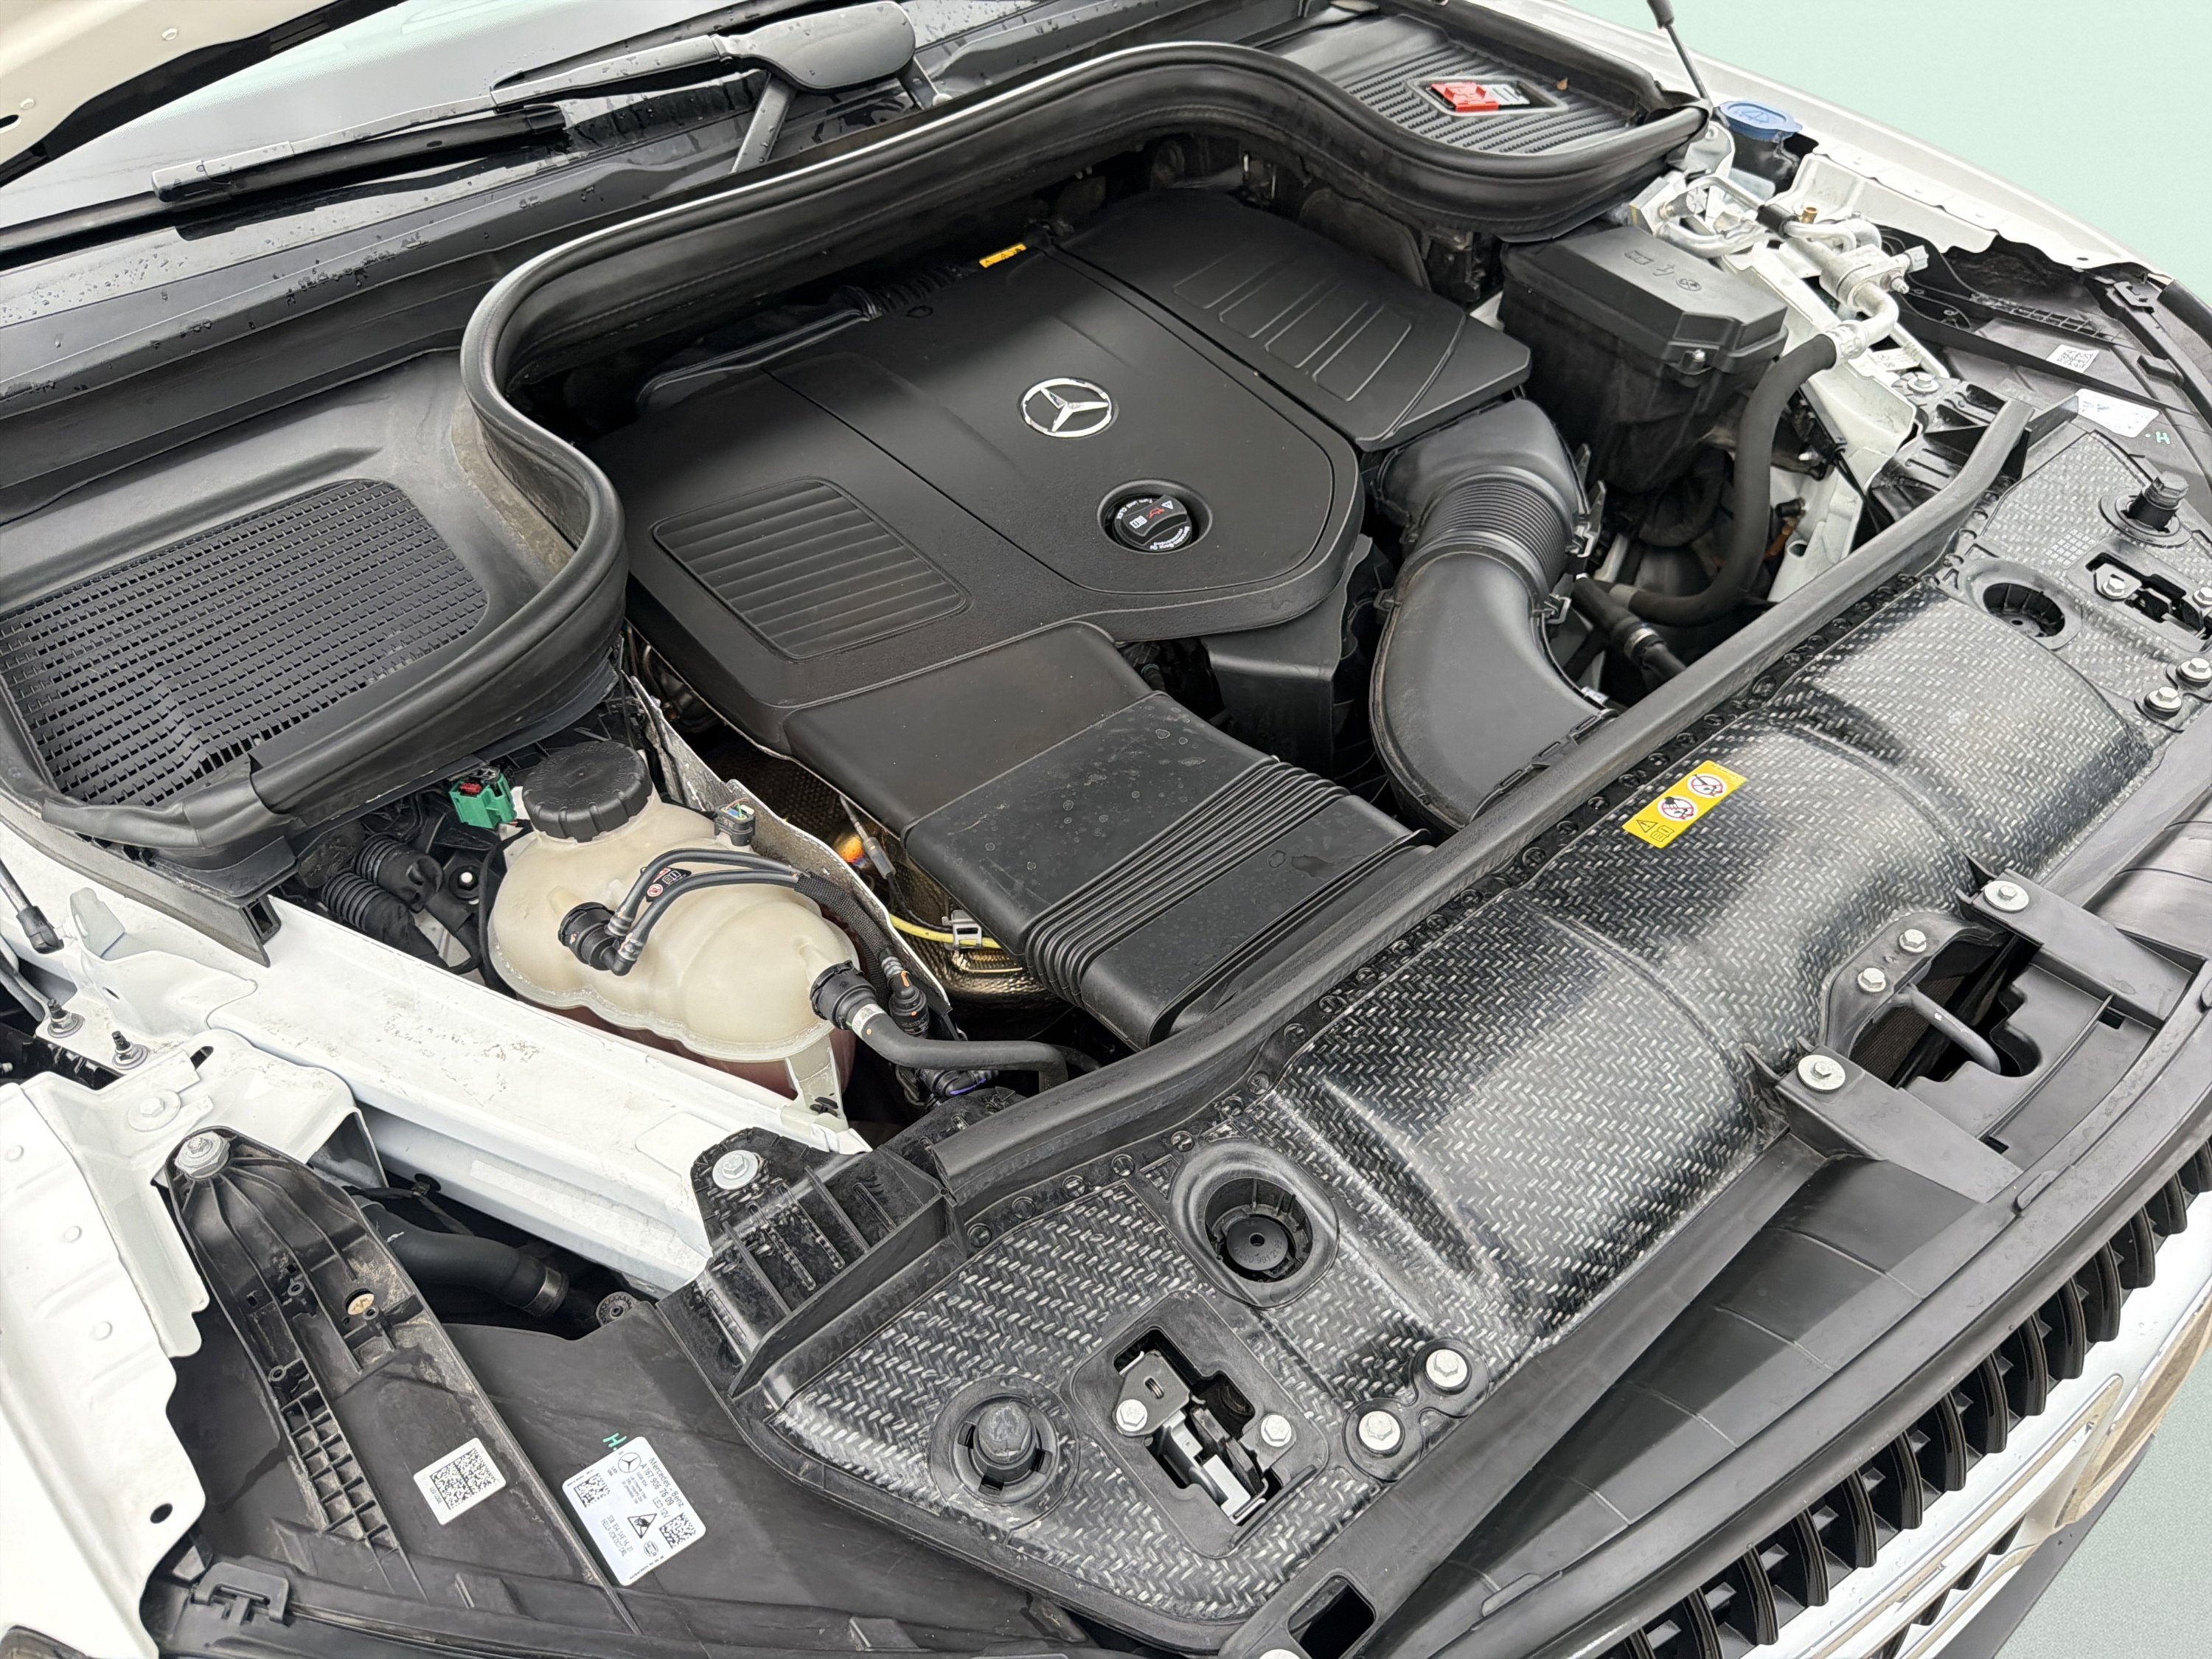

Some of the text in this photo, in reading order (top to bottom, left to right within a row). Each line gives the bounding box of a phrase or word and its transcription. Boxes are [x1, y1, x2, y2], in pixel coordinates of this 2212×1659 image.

[643, 1467, 655, 1480] 167
[650, 1476, 662, 1489] 906
[658, 1486, 669, 1498] 76
[664, 1495, 675, 1507] 09
[647, 1456, 672, 1488] Mercedes
[669, 1489, 686, 1509] Benz
[651, 1496, 670, 1520] LED 12V
